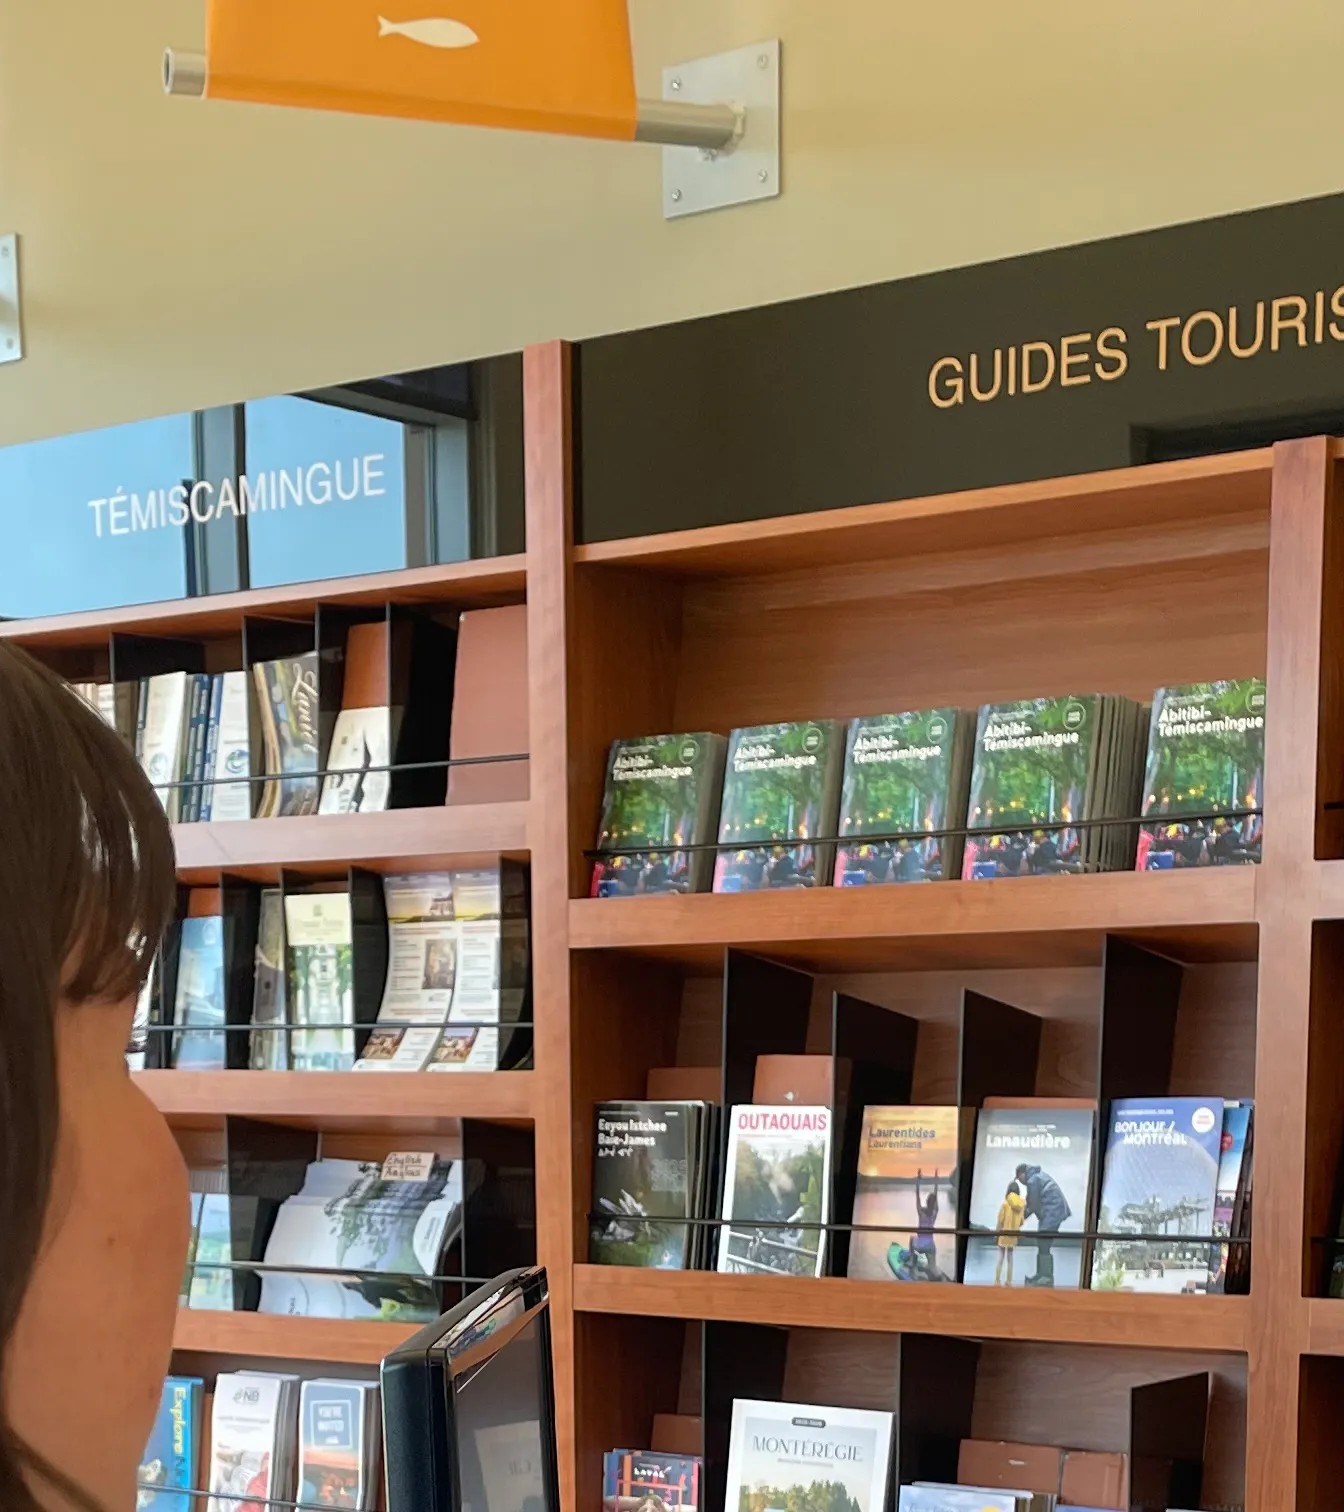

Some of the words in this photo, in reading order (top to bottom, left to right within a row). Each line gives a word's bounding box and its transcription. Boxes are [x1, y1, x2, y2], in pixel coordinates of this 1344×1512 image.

[928, 328, 1129, 408] GUIDES
[87, 453, 387, 538] TÉMISCAMINGUE
[1159, 708, 1212, 722] Abitibi-
[984, 724, 1032, 738] Abitibi-
[1159, 716, 1263, 737] Témiscamingue
[984, 732, 1079, 751] Témiscamingue
[737, 1113, 827, 1130] OUTAOUAIS
[869, 1126, 935, 1138] Laurentides
[986, 1133, 1071, 1149] Lanaudière
[752, 1435, 863, 1462] MONTÉRÉGIE
